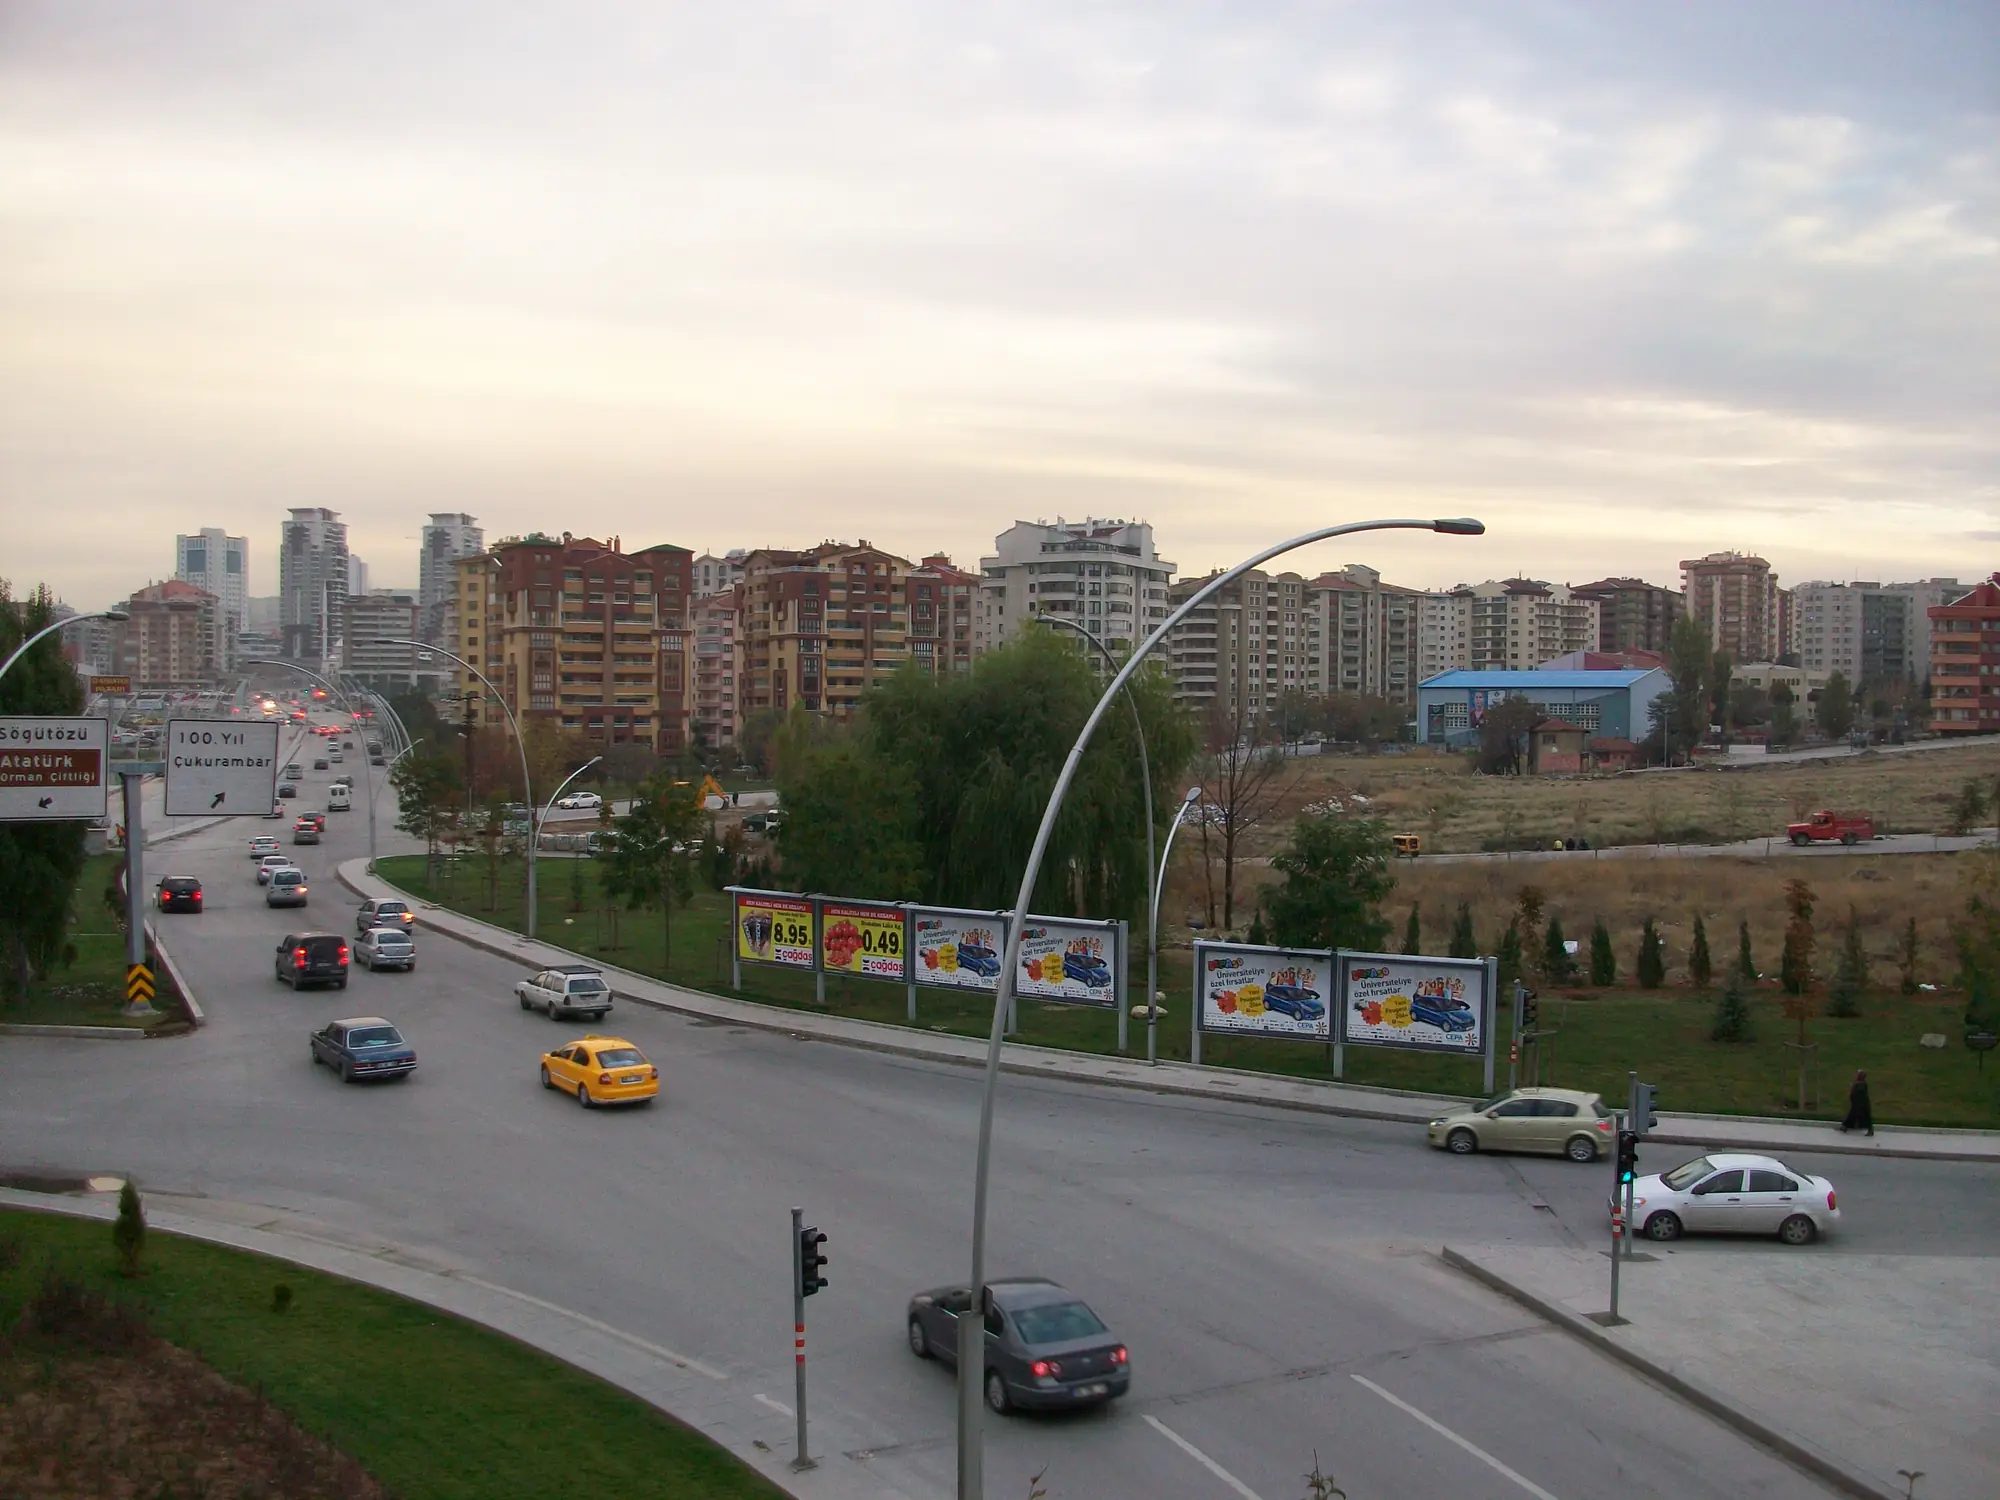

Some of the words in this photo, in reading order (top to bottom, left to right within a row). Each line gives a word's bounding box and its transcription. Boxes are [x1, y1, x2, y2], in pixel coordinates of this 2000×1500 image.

[1, 754, 73, 768] Atatürk
[174, 755, 272, 769] Çukurambar
[0, 772, 43, 782] Orman
[50, 771, 95, 784] Çiftliği
[774, 922, 808, 945] 8.95
[863, 929, 900, 955] 0.49
[1216, 967, 1265, 979] Üniversiteliye
[1210, 979, 1225, 988] özel
[1360, 976, 1412, 989] Üniversiteliye
[1354, 988, 1370, 998] özel
[1296, 1021, 1314, 1030] CEPA
[1445, 1033, 1464, 1041] CEPA
